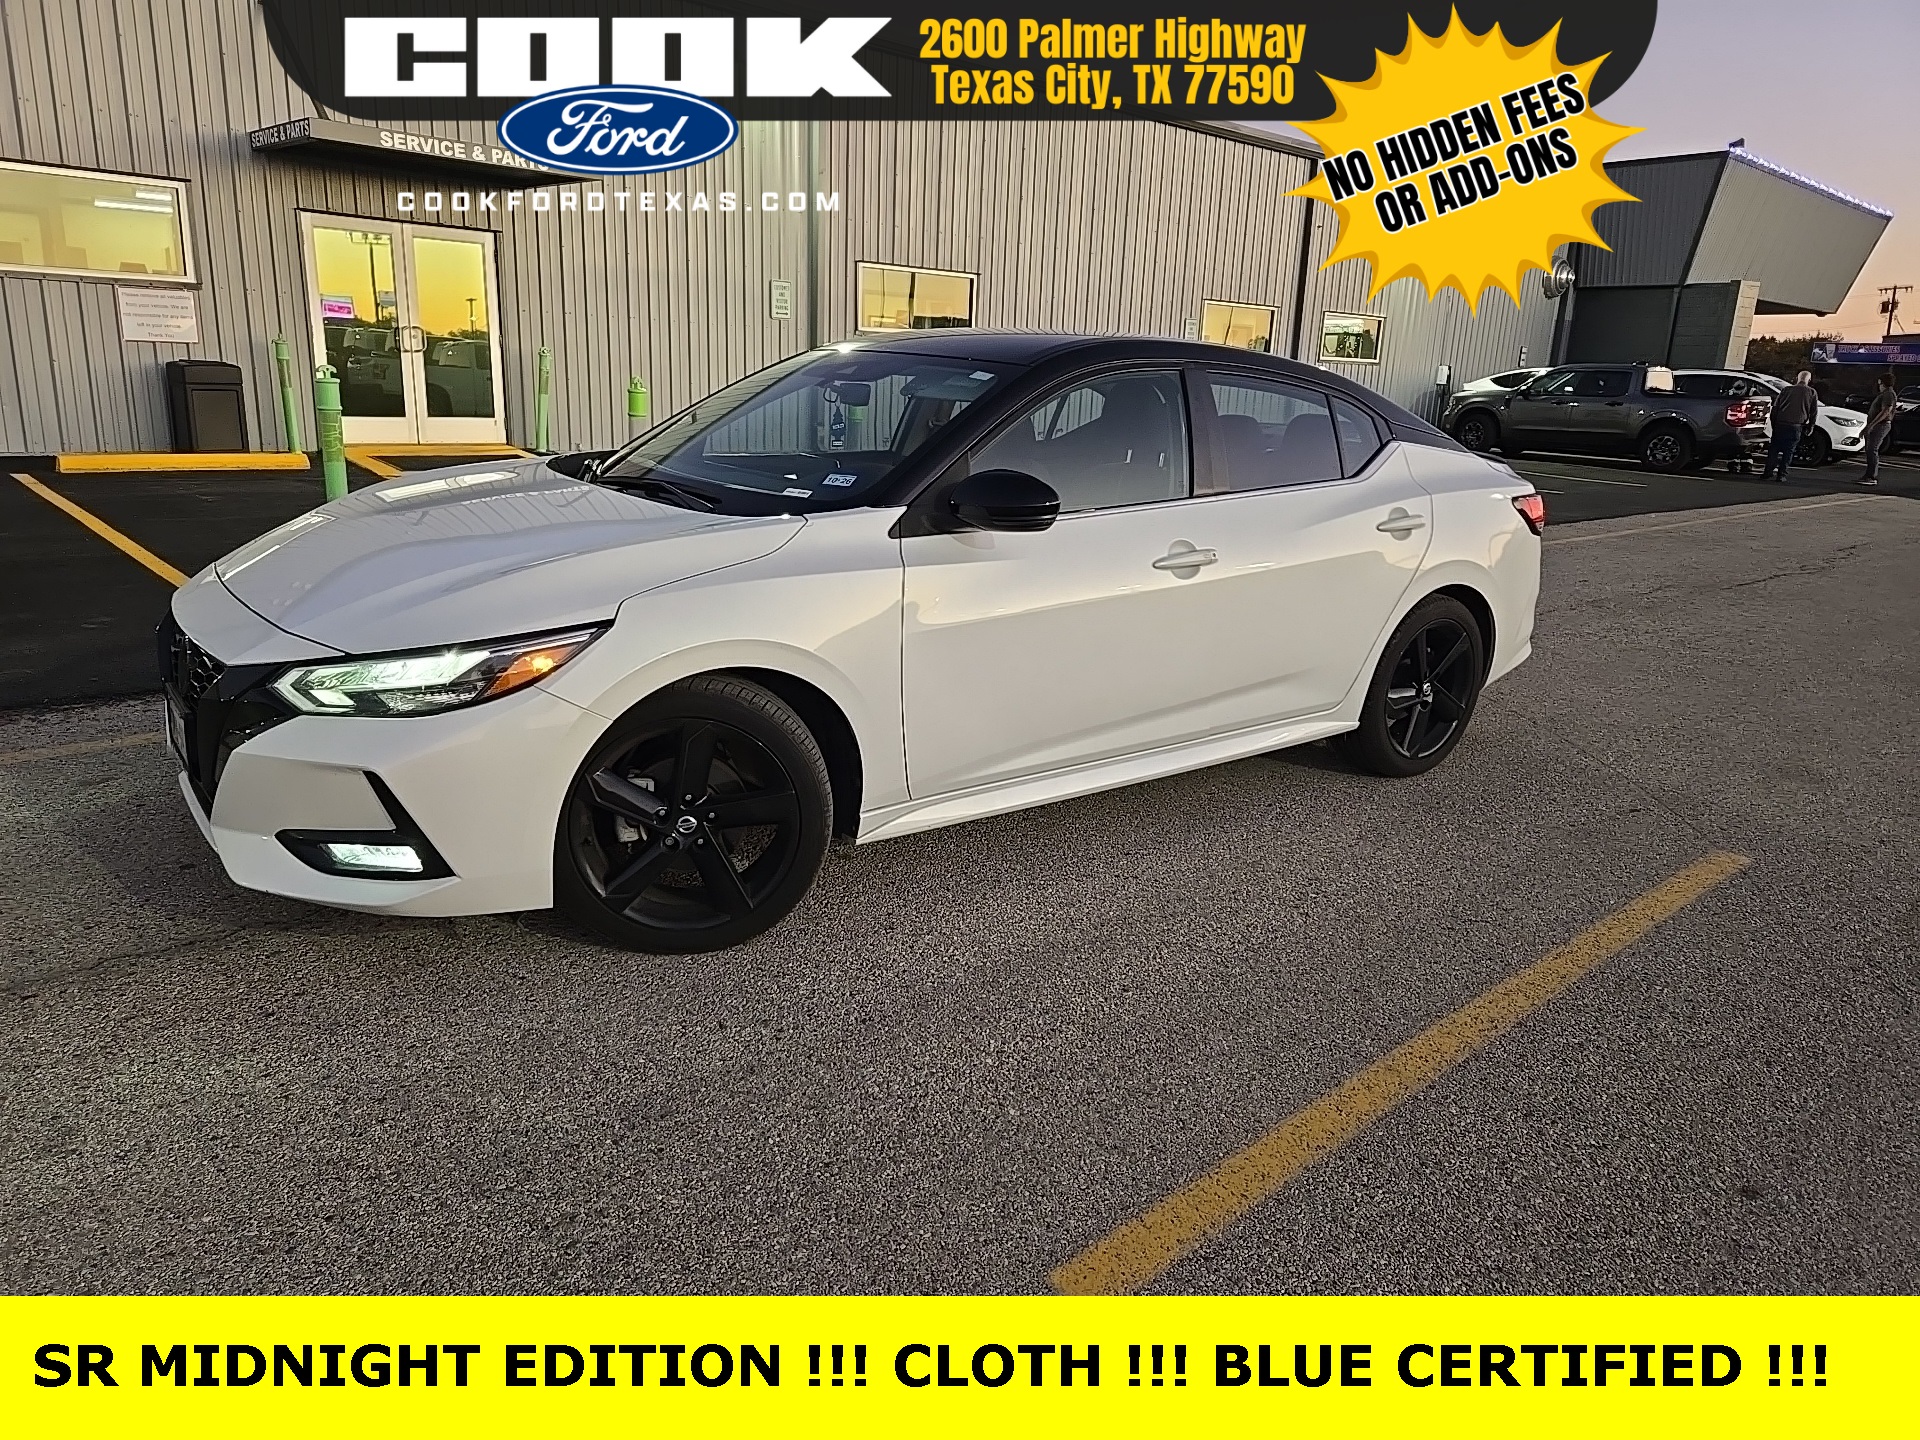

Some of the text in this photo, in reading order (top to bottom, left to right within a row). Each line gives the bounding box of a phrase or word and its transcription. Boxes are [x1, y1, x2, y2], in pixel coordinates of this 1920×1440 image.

[251, 119, 310, 148] SERVICE & PARTS
[380, 130, 467, 159] SERVICE
[472, 145, 487, 161] &
